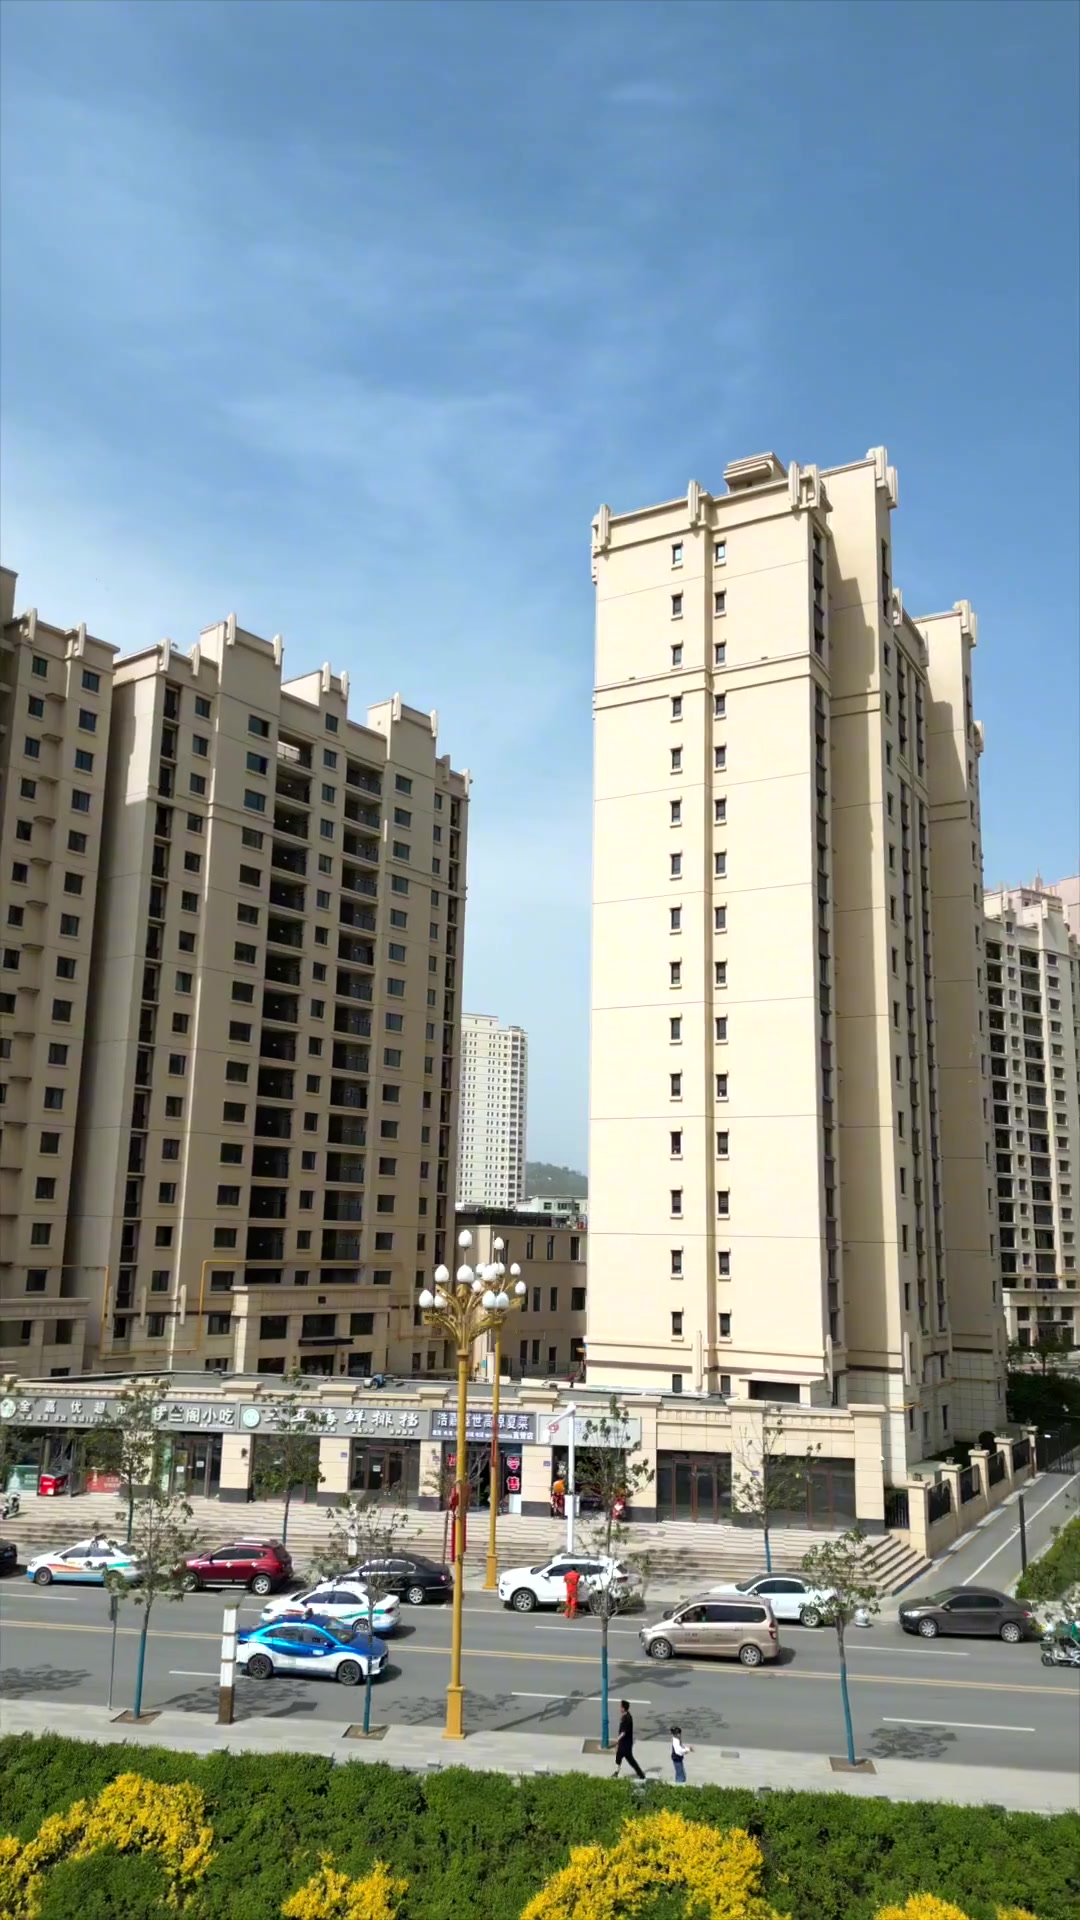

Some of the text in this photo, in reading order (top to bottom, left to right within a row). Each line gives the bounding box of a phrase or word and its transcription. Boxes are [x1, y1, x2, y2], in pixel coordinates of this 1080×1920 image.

[152, 1405, 234, 1425] 伊兰阁小吃
